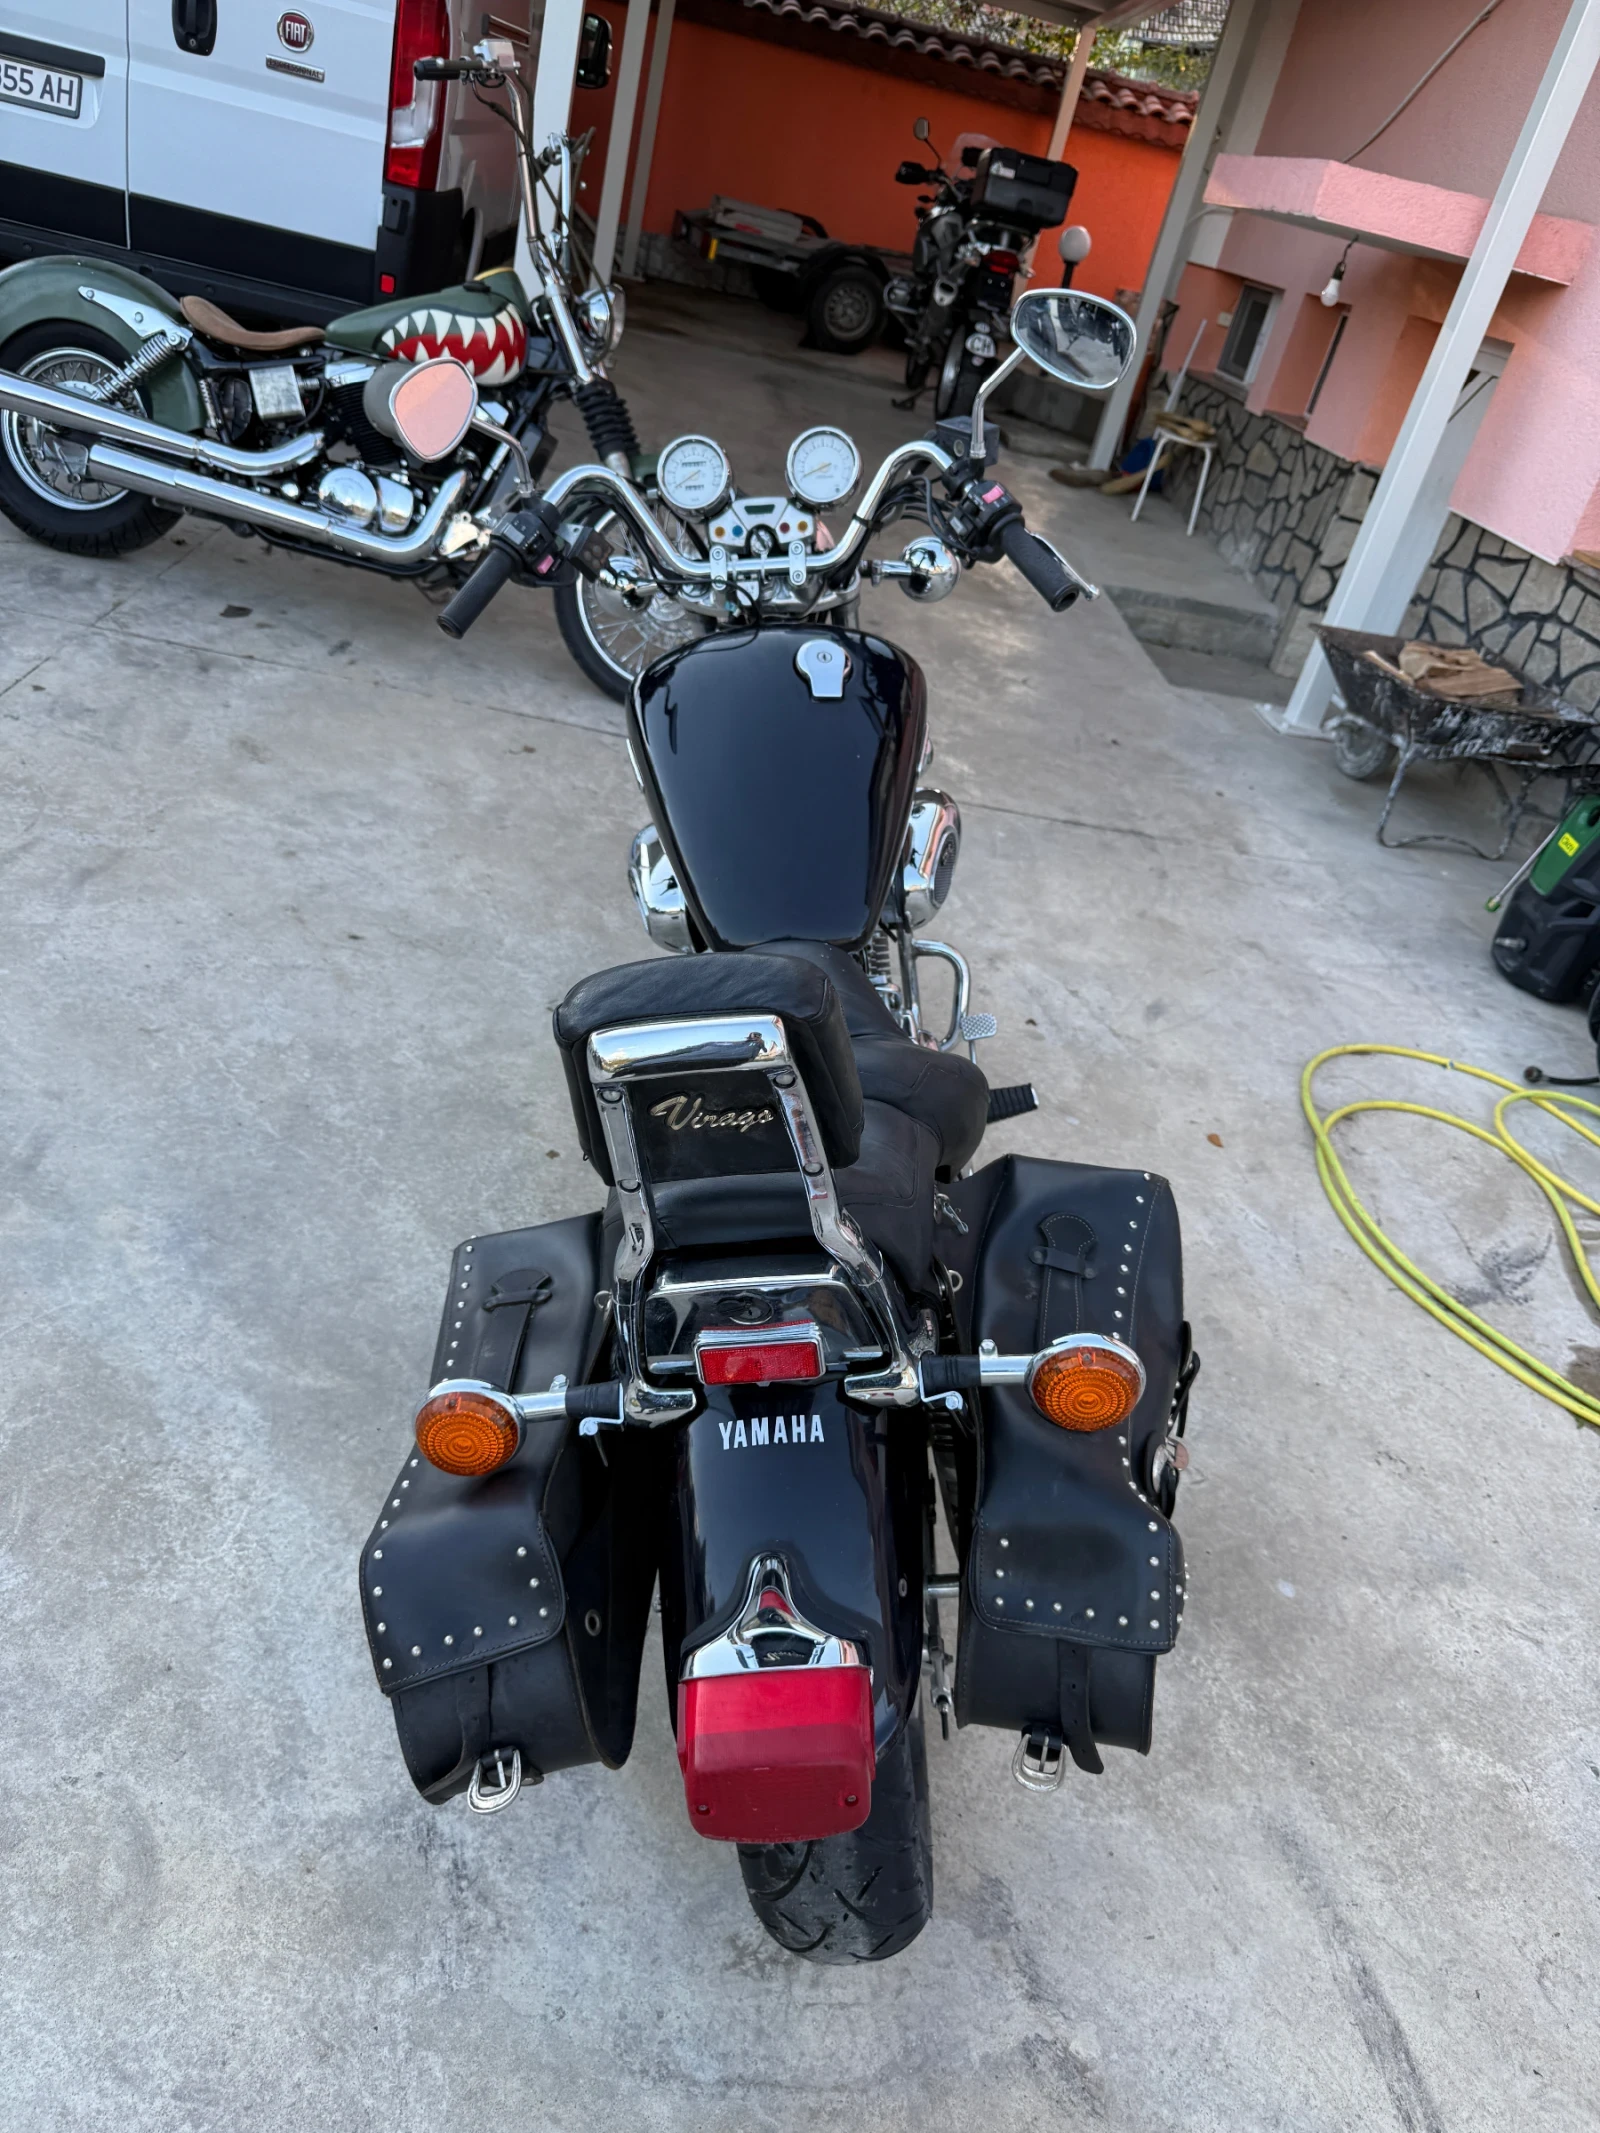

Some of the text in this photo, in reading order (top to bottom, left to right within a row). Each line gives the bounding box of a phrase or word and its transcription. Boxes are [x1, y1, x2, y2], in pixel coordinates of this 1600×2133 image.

[285, 20, 307, 43] FIAT
[0, 63, 74, 106] 55 AH
[971, 336, 992, 355] CH
[650, 1095, 774, 1132] Virago
[718, 1414, 825, 1450] YAMAHA
